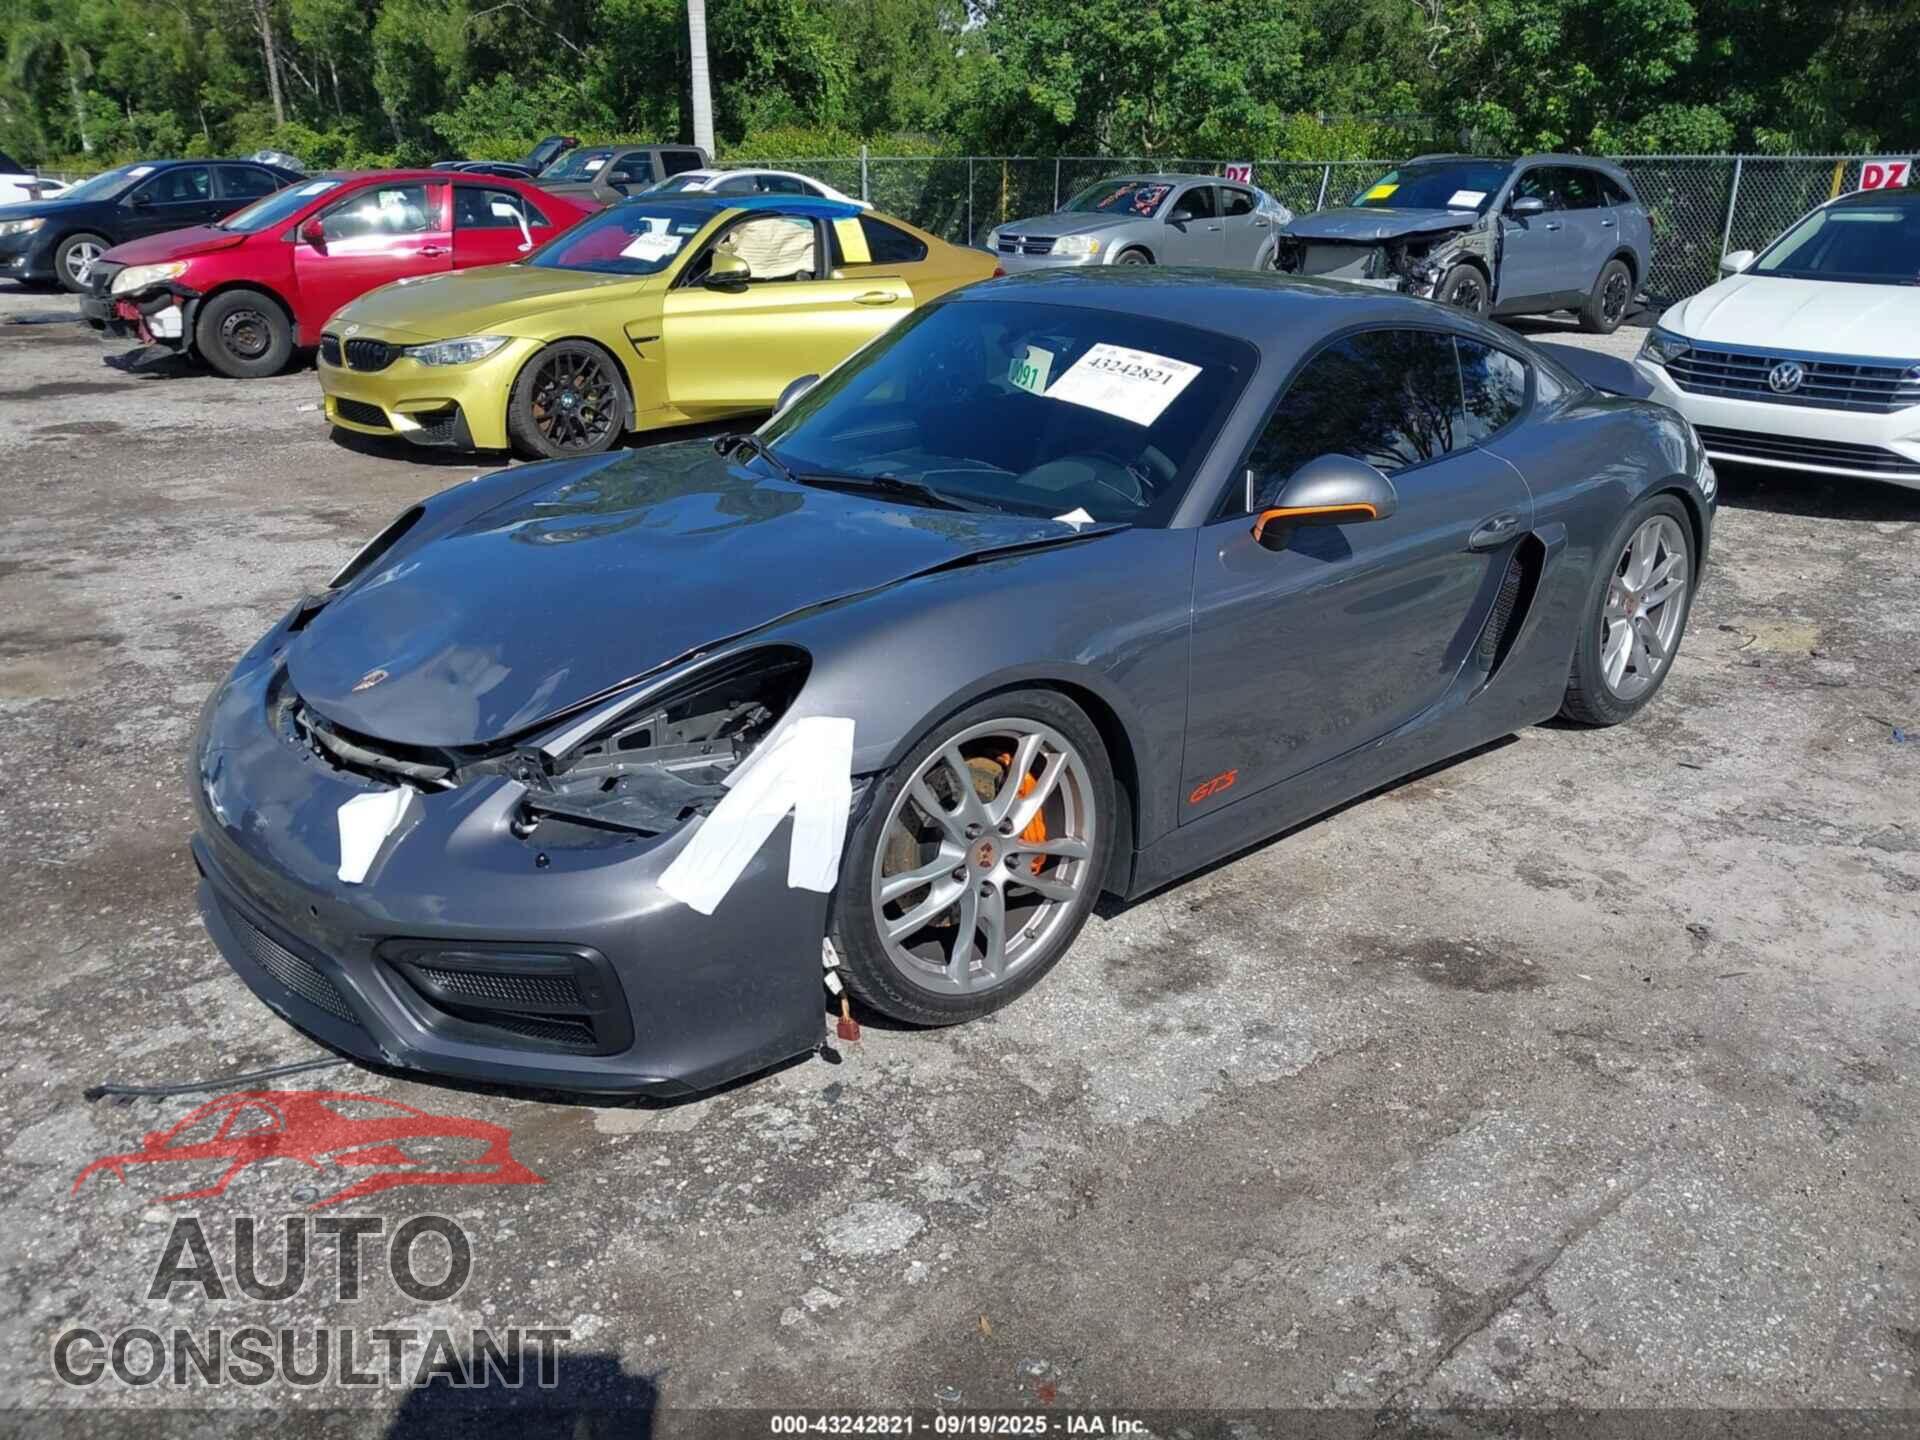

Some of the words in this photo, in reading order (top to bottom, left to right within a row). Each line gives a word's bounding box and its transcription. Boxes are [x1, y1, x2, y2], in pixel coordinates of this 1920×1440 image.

[1227, 167, 1249, 183] DZ
[1863, 164, 1907, 189] DZ
[1088, 358, 1174, 385] 43242821
[1189, 768, 1238, 804] GTS
